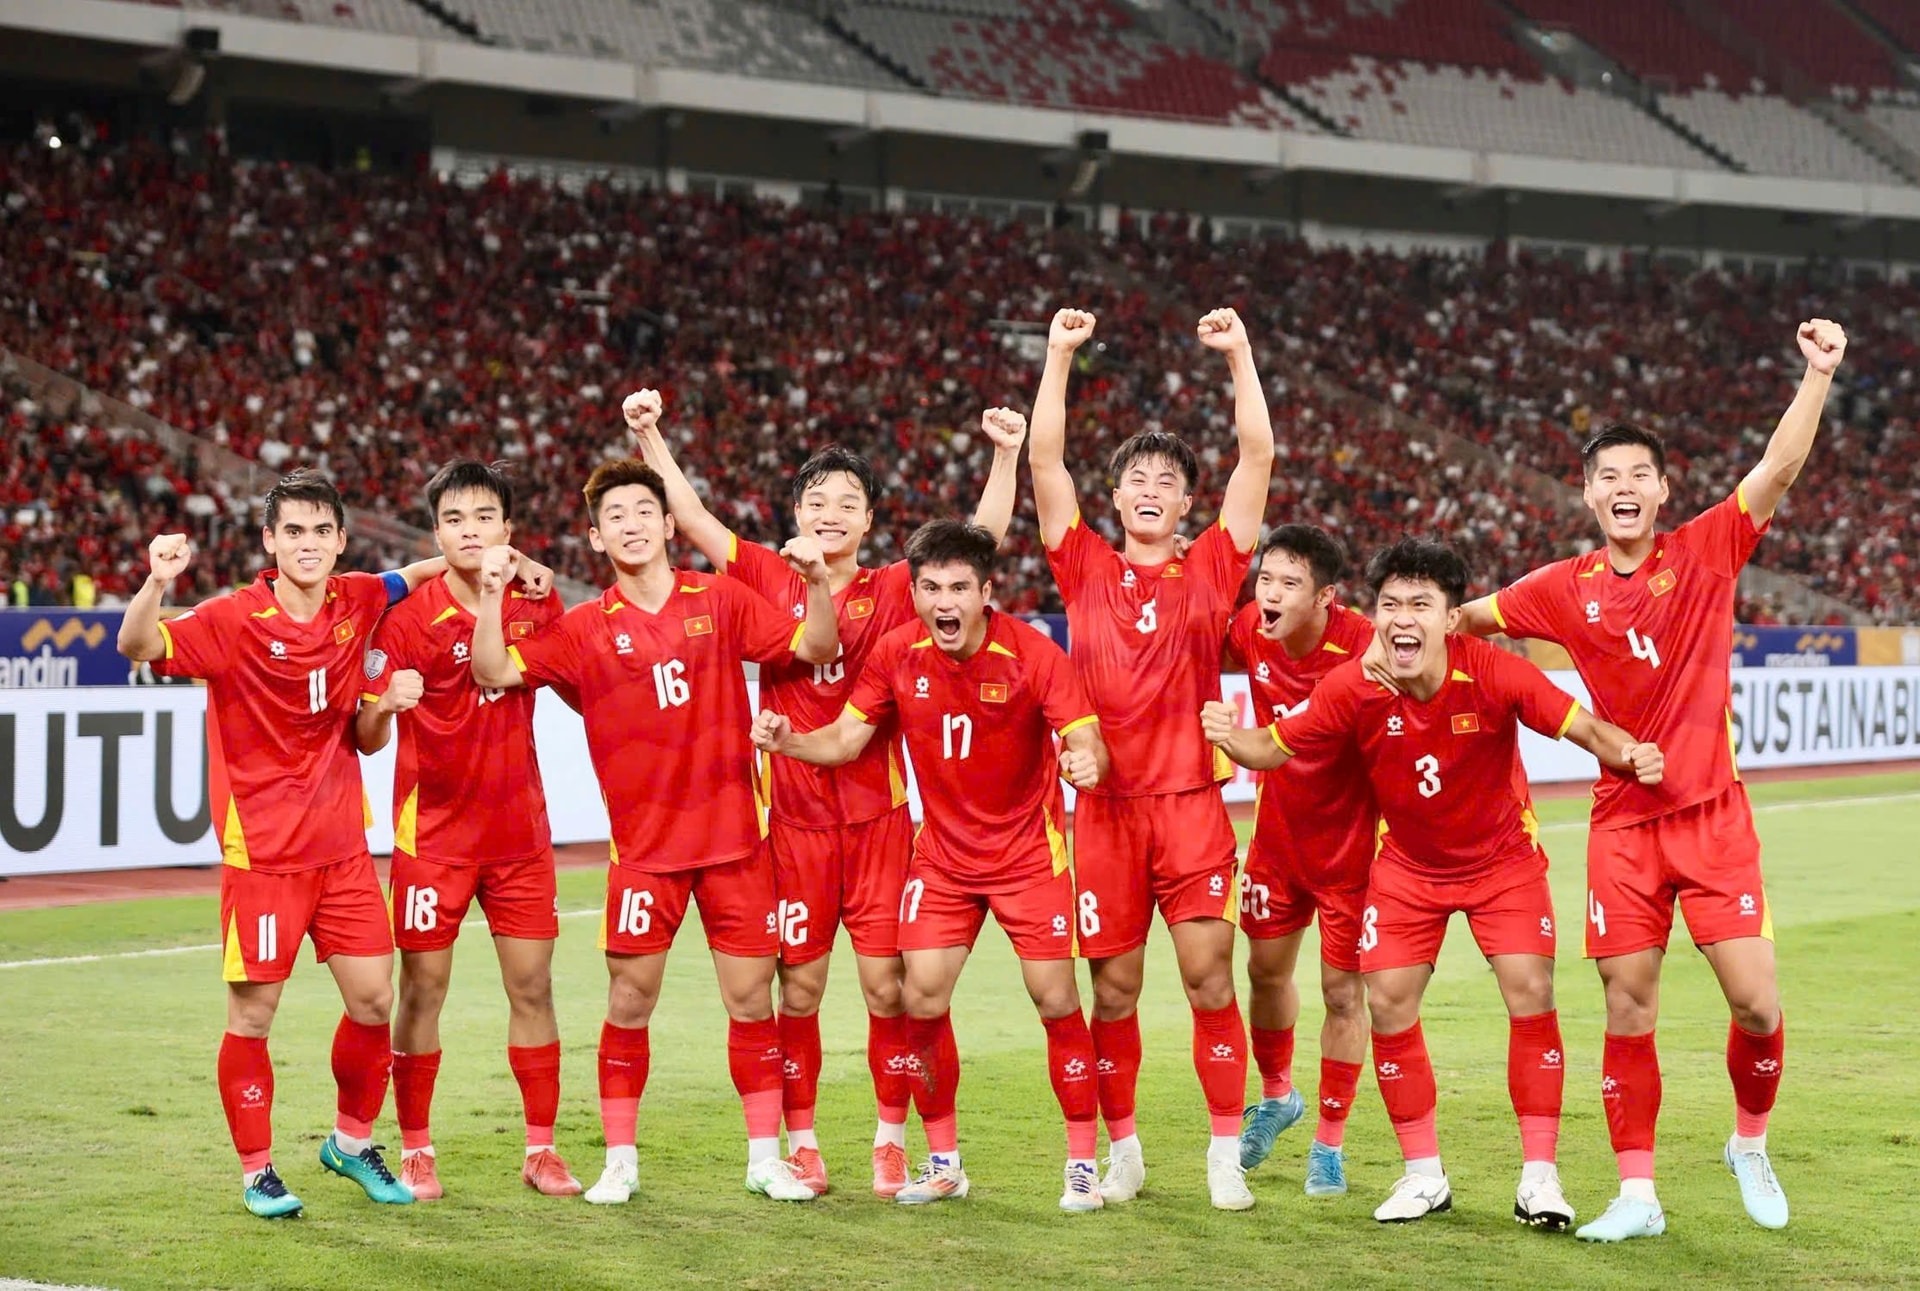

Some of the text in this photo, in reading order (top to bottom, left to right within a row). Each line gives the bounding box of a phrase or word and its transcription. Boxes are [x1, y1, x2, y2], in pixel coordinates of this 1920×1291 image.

[1626, 627, 1661, 669] 4
[308, 667, 328, 714] 11
[652, 658, 691, 710] 16
[943, 713, 973, 760] 17
[1415, 754, 1442, 798] 3
[404, 885, 438, 932] 18
[618, 887, 654, 936] 16
[778, 899, 809, 946] 12
[1079, 890, 1101, 937] 8
[1589, 889, 1607, 937] 4
[258, 914, 277, 962] 11
